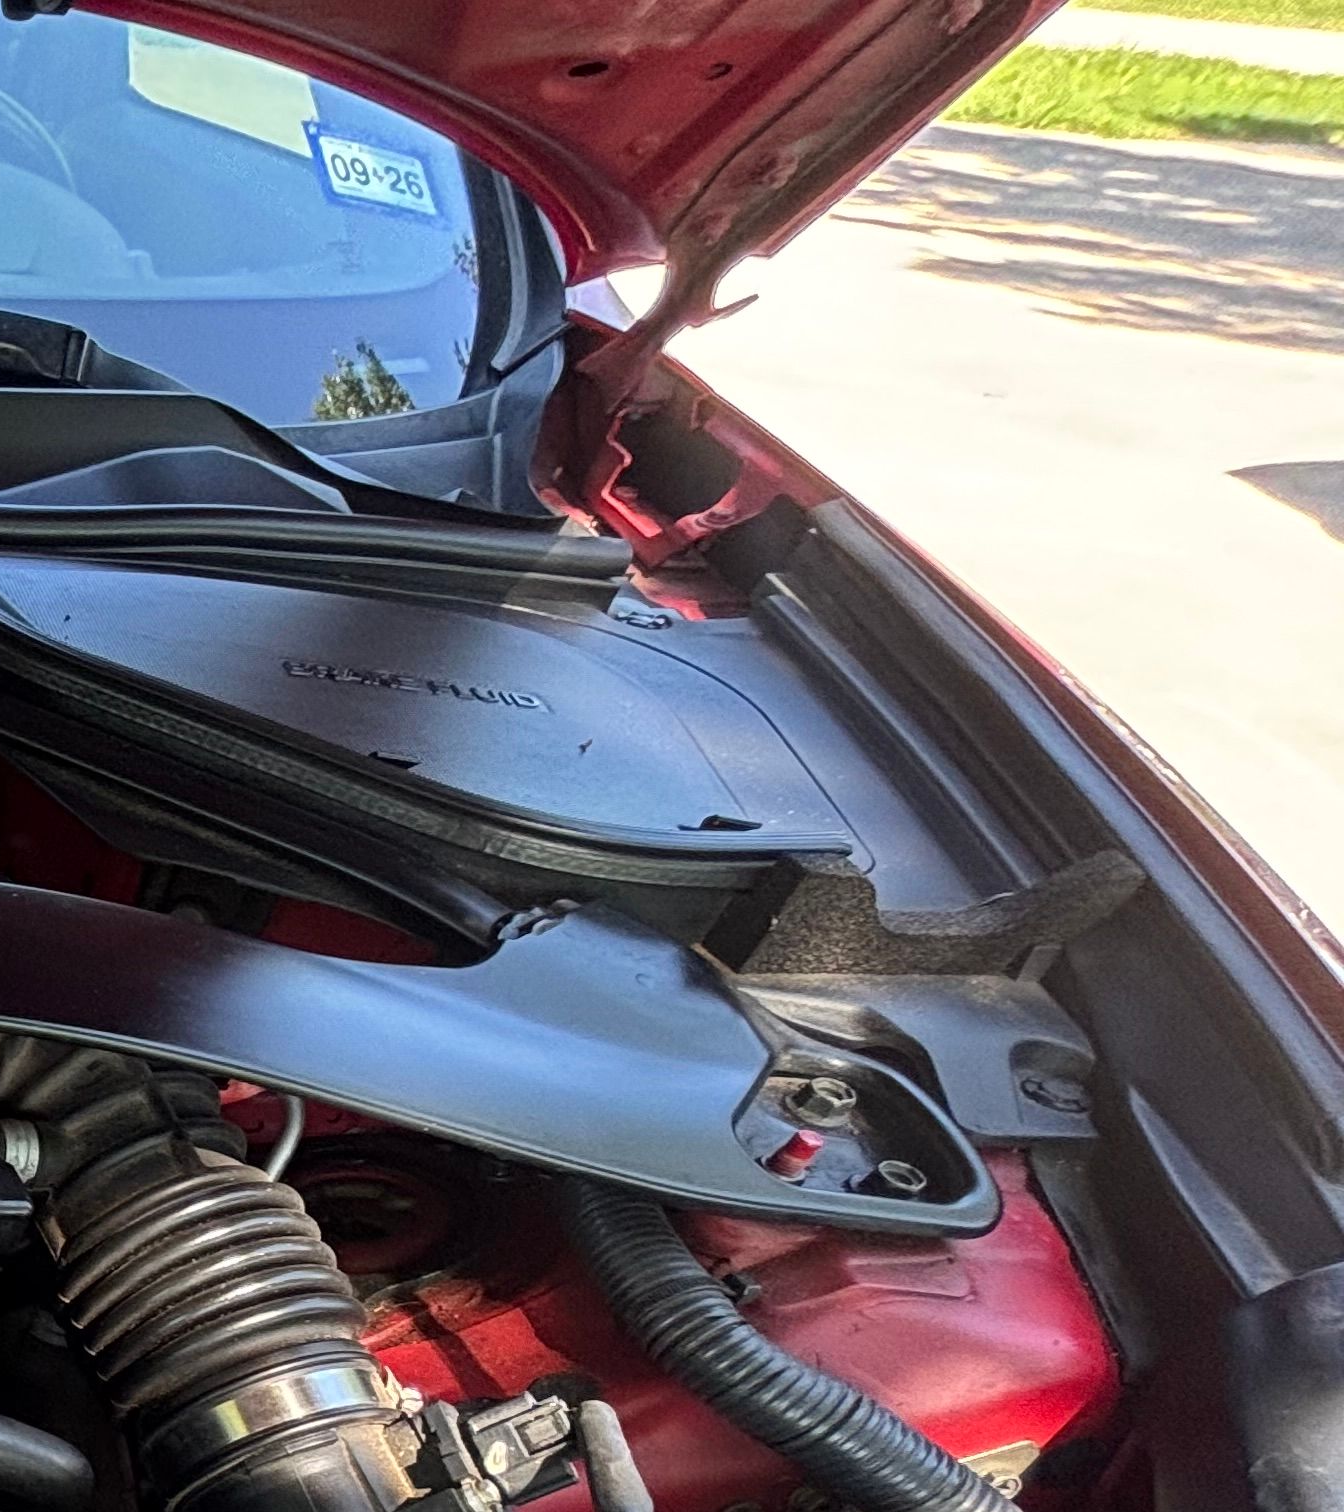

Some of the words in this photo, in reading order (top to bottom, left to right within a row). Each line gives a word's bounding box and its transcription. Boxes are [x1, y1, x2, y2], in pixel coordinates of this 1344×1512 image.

[331, 153, 370, 185] 09
[384, 166, 424, 199] 26
[426, 679, 544, 709] FLUID
